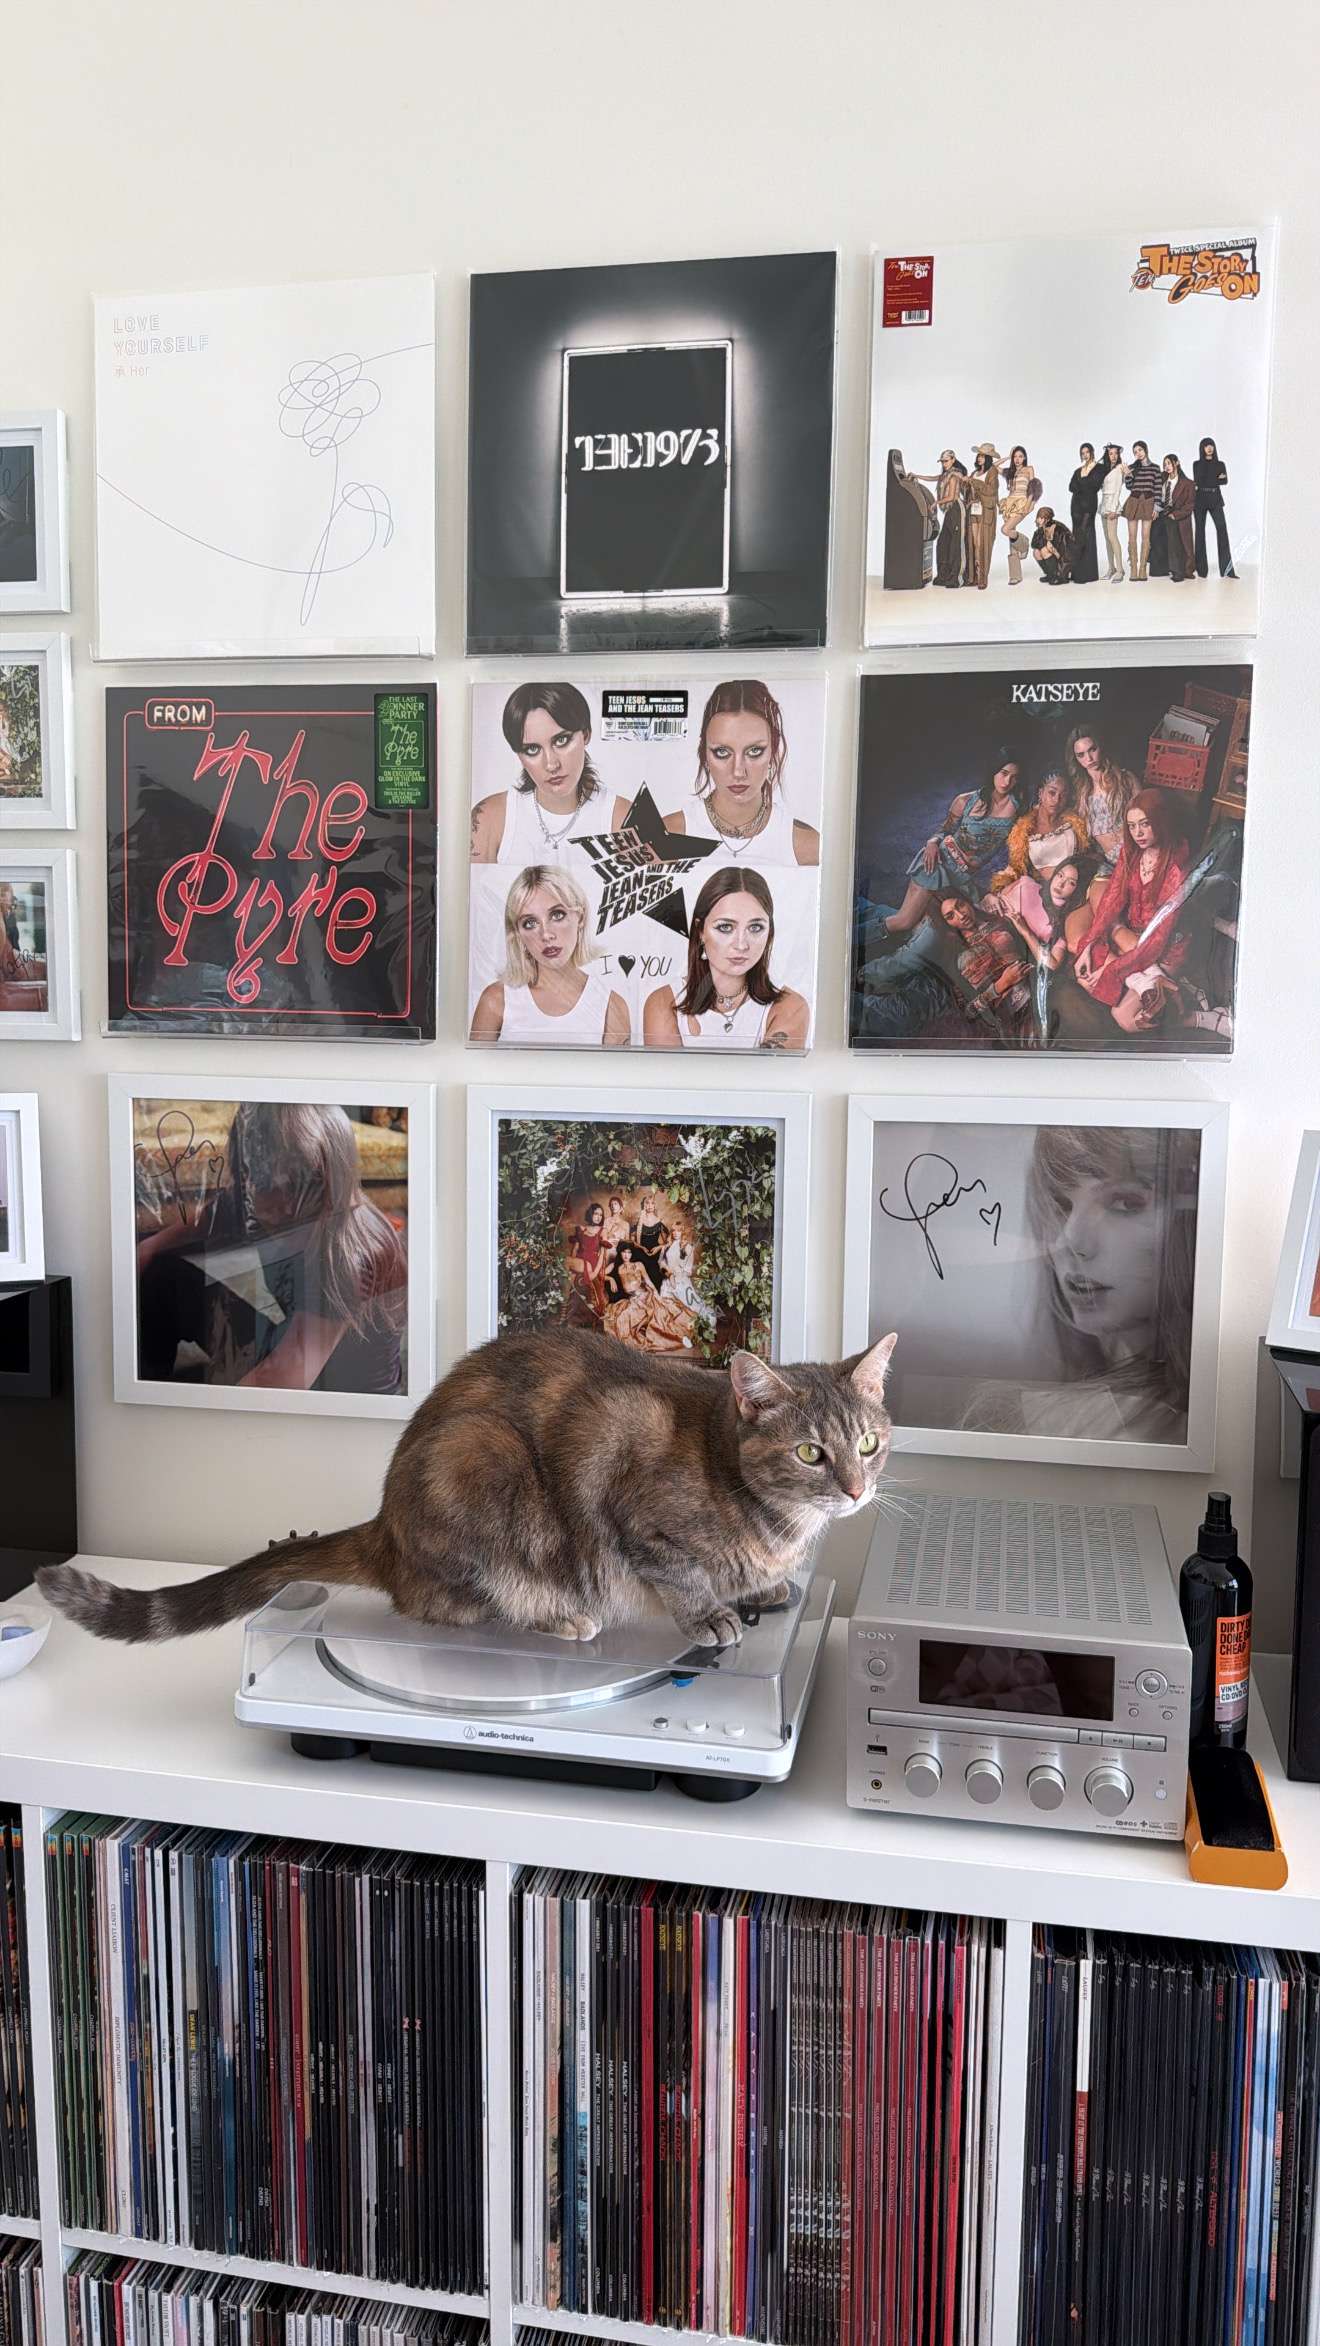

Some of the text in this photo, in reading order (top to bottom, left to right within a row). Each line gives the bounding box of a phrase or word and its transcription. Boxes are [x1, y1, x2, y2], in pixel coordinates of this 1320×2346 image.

[1170, 237, 1257, 256] TWICE SPECIAL ALBUM
[1140, 244, 1250, 277] THE STORY
[1168, 272, 1261, 304] GOES ON
[113, 314, 160, 333] LOVE
[113, 335, 209, 356] YOURSELF
[130, 366, 150, 377] Her
[608, 695, 647, 705] TEEN JESUS
[1011, 681, 1101, 703] KATSEYE
[153, 704, 206, 724] FROM
[389, 702, 425, 711] DINNER
[390, 710, 418, 720] PARTY
[608, 704, 623, 713] AND
[624, 704, 637, 713] THE
[637, 704, 654, 713] JEAN
[193, 729, 369, 862] The
[567, 830, 639, 862] TEEN
[590, 846, 655, 885] JESUS
[646, 858, 702, 873] AND THE
[599, 870, 645, 909] JEAN
[596, 876, 674, 937] TEASERS
[157, 853, 377, 1005] Pyre
[640, 956, 673, 980] YOU
[1220, 1618, 1246, 1633] DIRTY
[856, 1630, 897, 1641] SONY
[1220, 1631, 1244, 1645] DONE
[1220, 1643, 1246, 1656] CHEAP
[1220, 1684, 1240, 1695] VINYL
[478, 1730, 534, 1743] audio-technica
[737, 2084, 746, 2148] KATY PERRY
